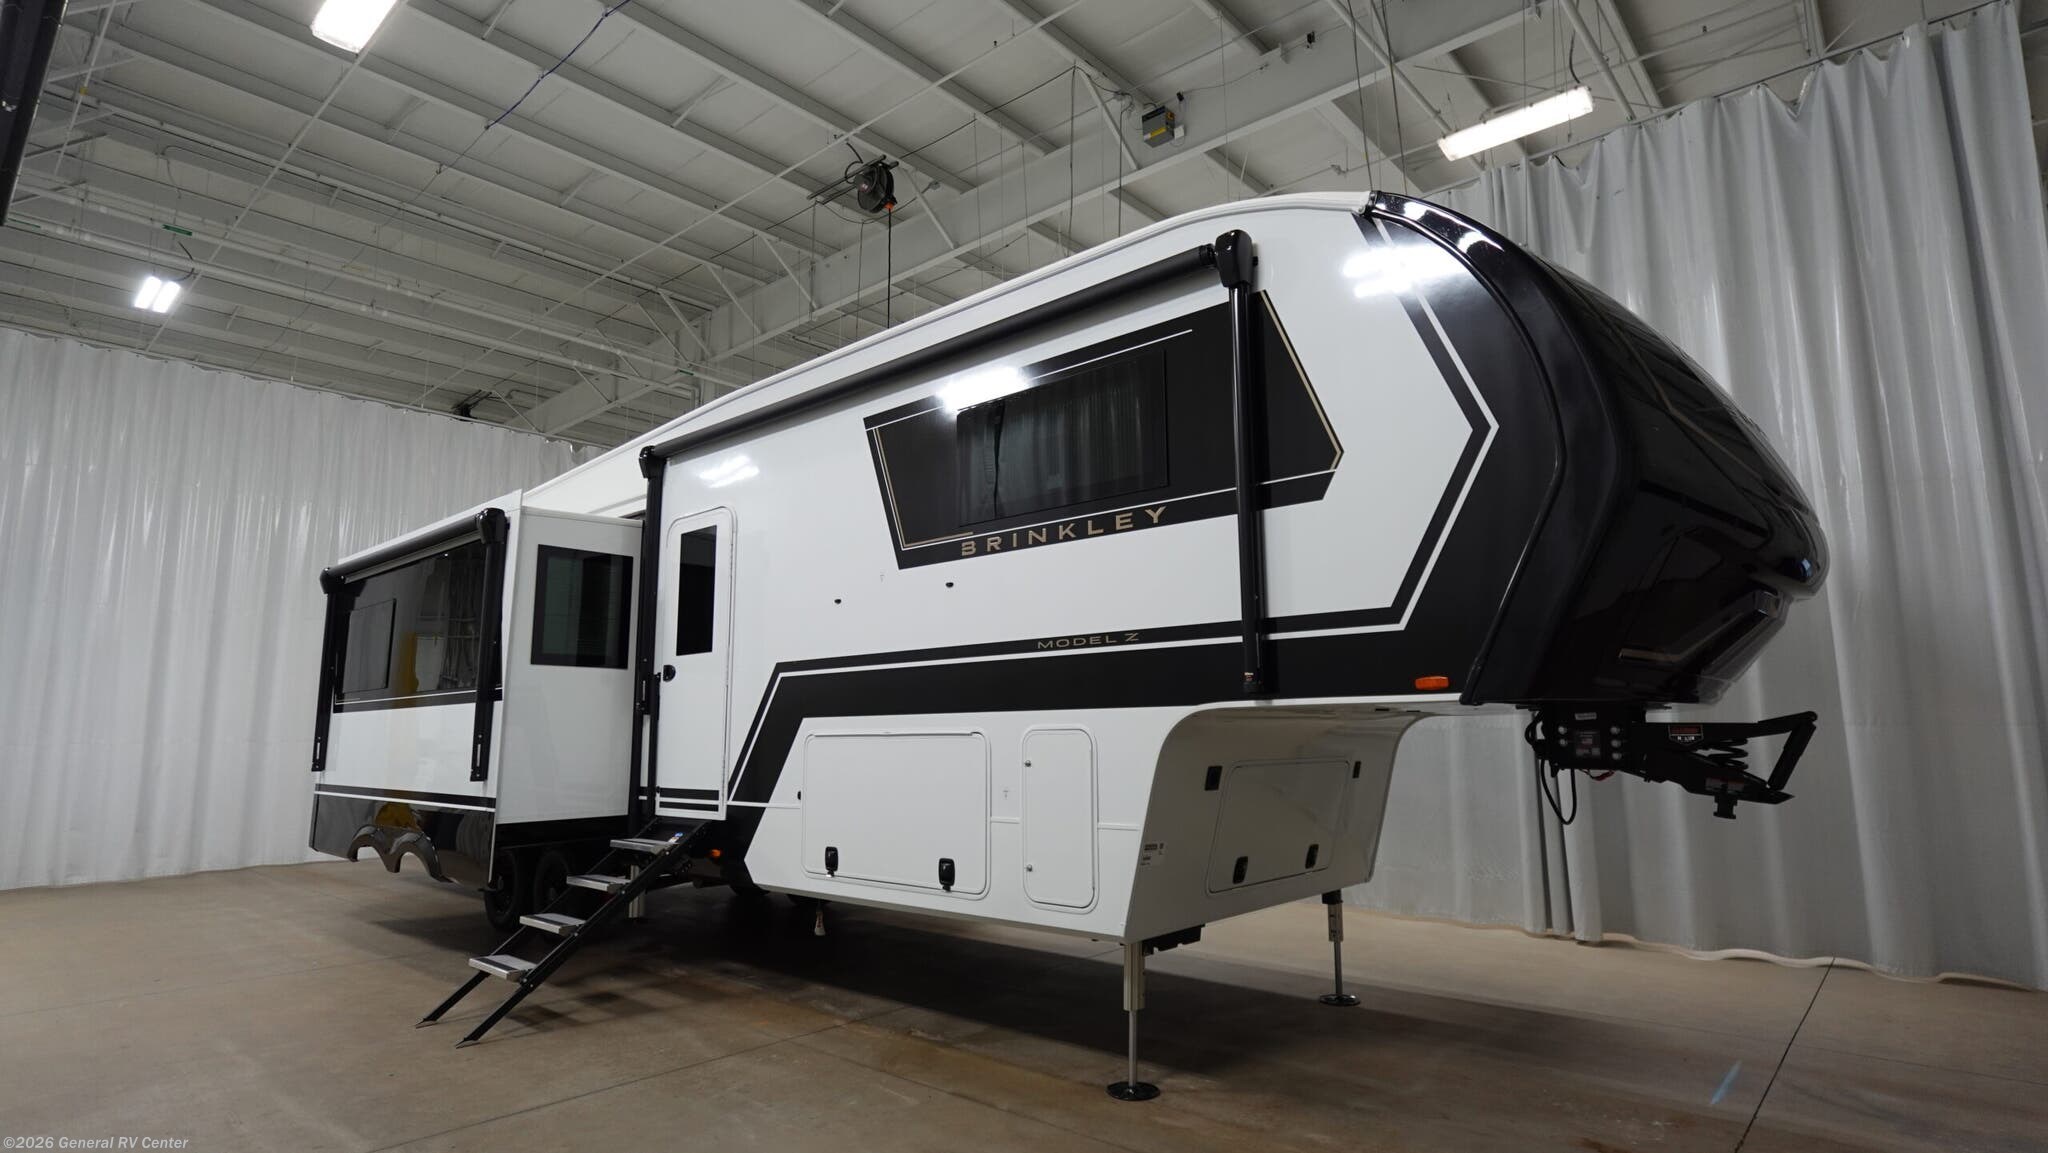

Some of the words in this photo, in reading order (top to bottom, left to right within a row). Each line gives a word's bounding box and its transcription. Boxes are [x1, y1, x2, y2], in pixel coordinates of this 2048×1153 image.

[961, 506, 1167, 556] BRINKLEY
[1037, 635, 1117, 649] MODEL
[1124, 632, 1140, 642] Z
